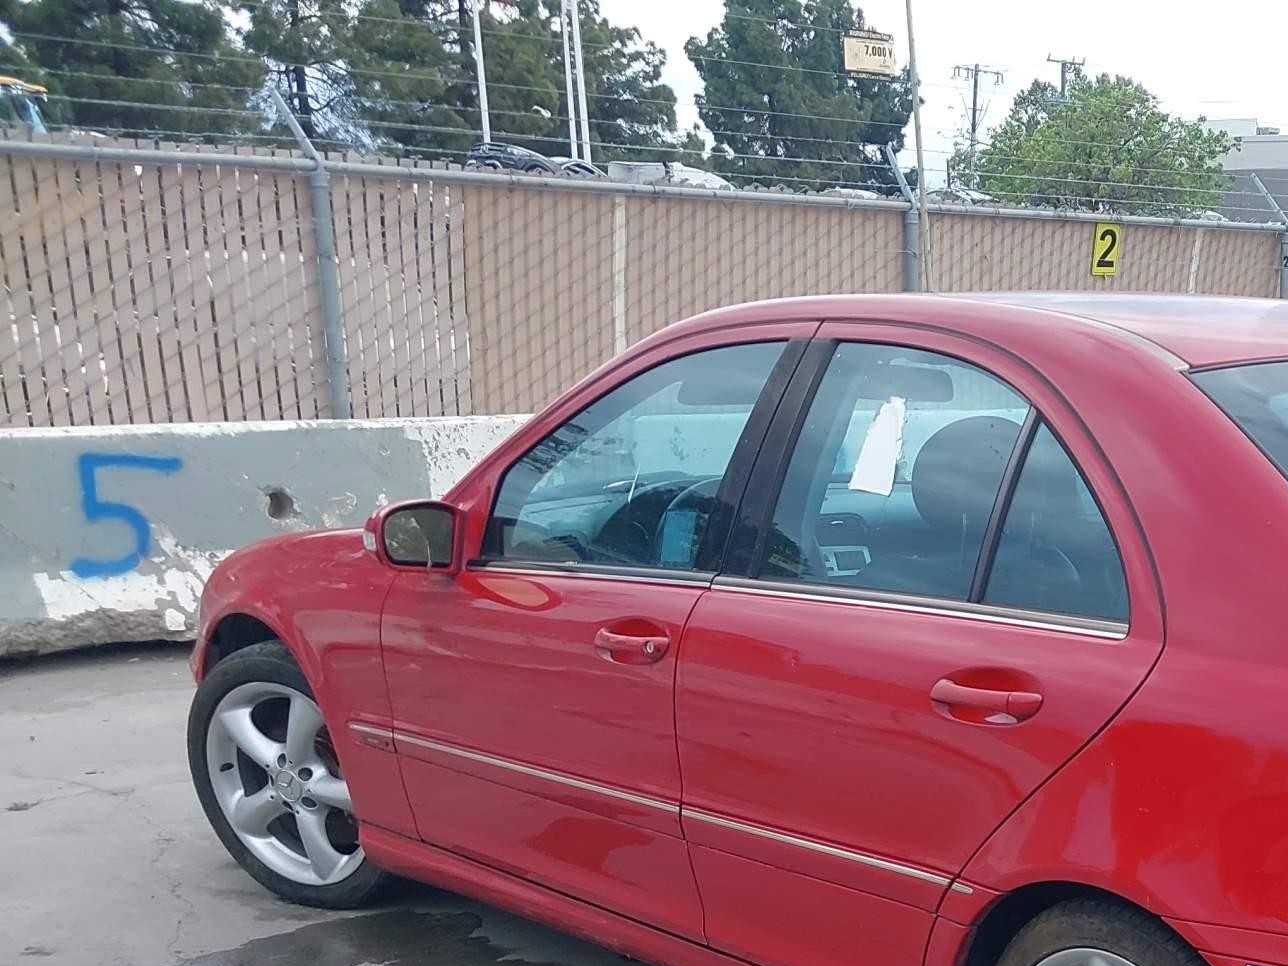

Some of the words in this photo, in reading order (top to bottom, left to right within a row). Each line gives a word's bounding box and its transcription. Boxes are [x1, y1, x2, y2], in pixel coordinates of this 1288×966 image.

[864, 45, 887, 58] 7,000
[887, 47, 893, 58] V
[1096, 229, 1117, 268] 2
[1283, 255, 1288, 268] 2
[70, 453, 183, 578] 5
